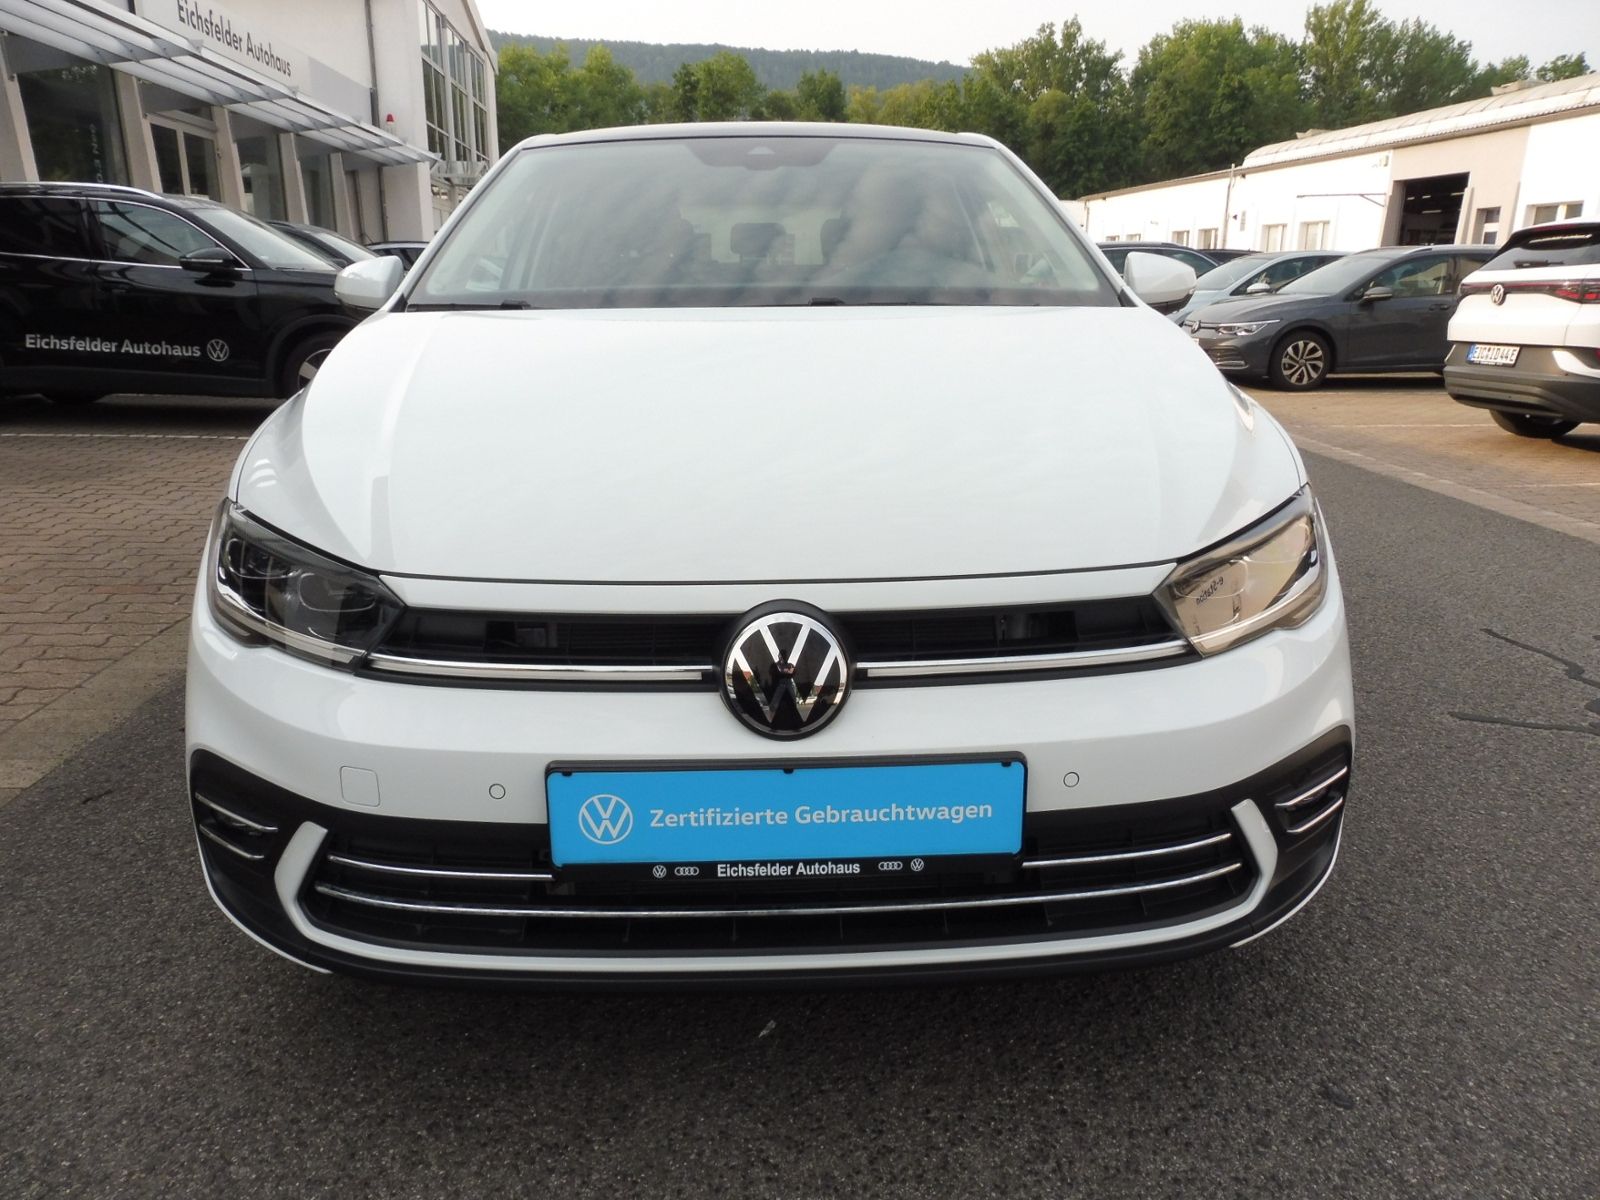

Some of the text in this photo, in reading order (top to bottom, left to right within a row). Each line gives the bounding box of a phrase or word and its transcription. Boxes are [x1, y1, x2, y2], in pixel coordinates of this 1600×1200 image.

[177, 0, 291, 77] Eichsfelder Autohaus
[25, 334, 118, 352] Eichsfelder
[121, 339, 201, 357] Autohaus
[650, 809, 788, 828] Zertifizierte
[794, 803, 992, 826] Gebrauchtwagen
[717, 861, 793, 878] Eichsfelder
[796, 861, 861, 876] Autohaus
